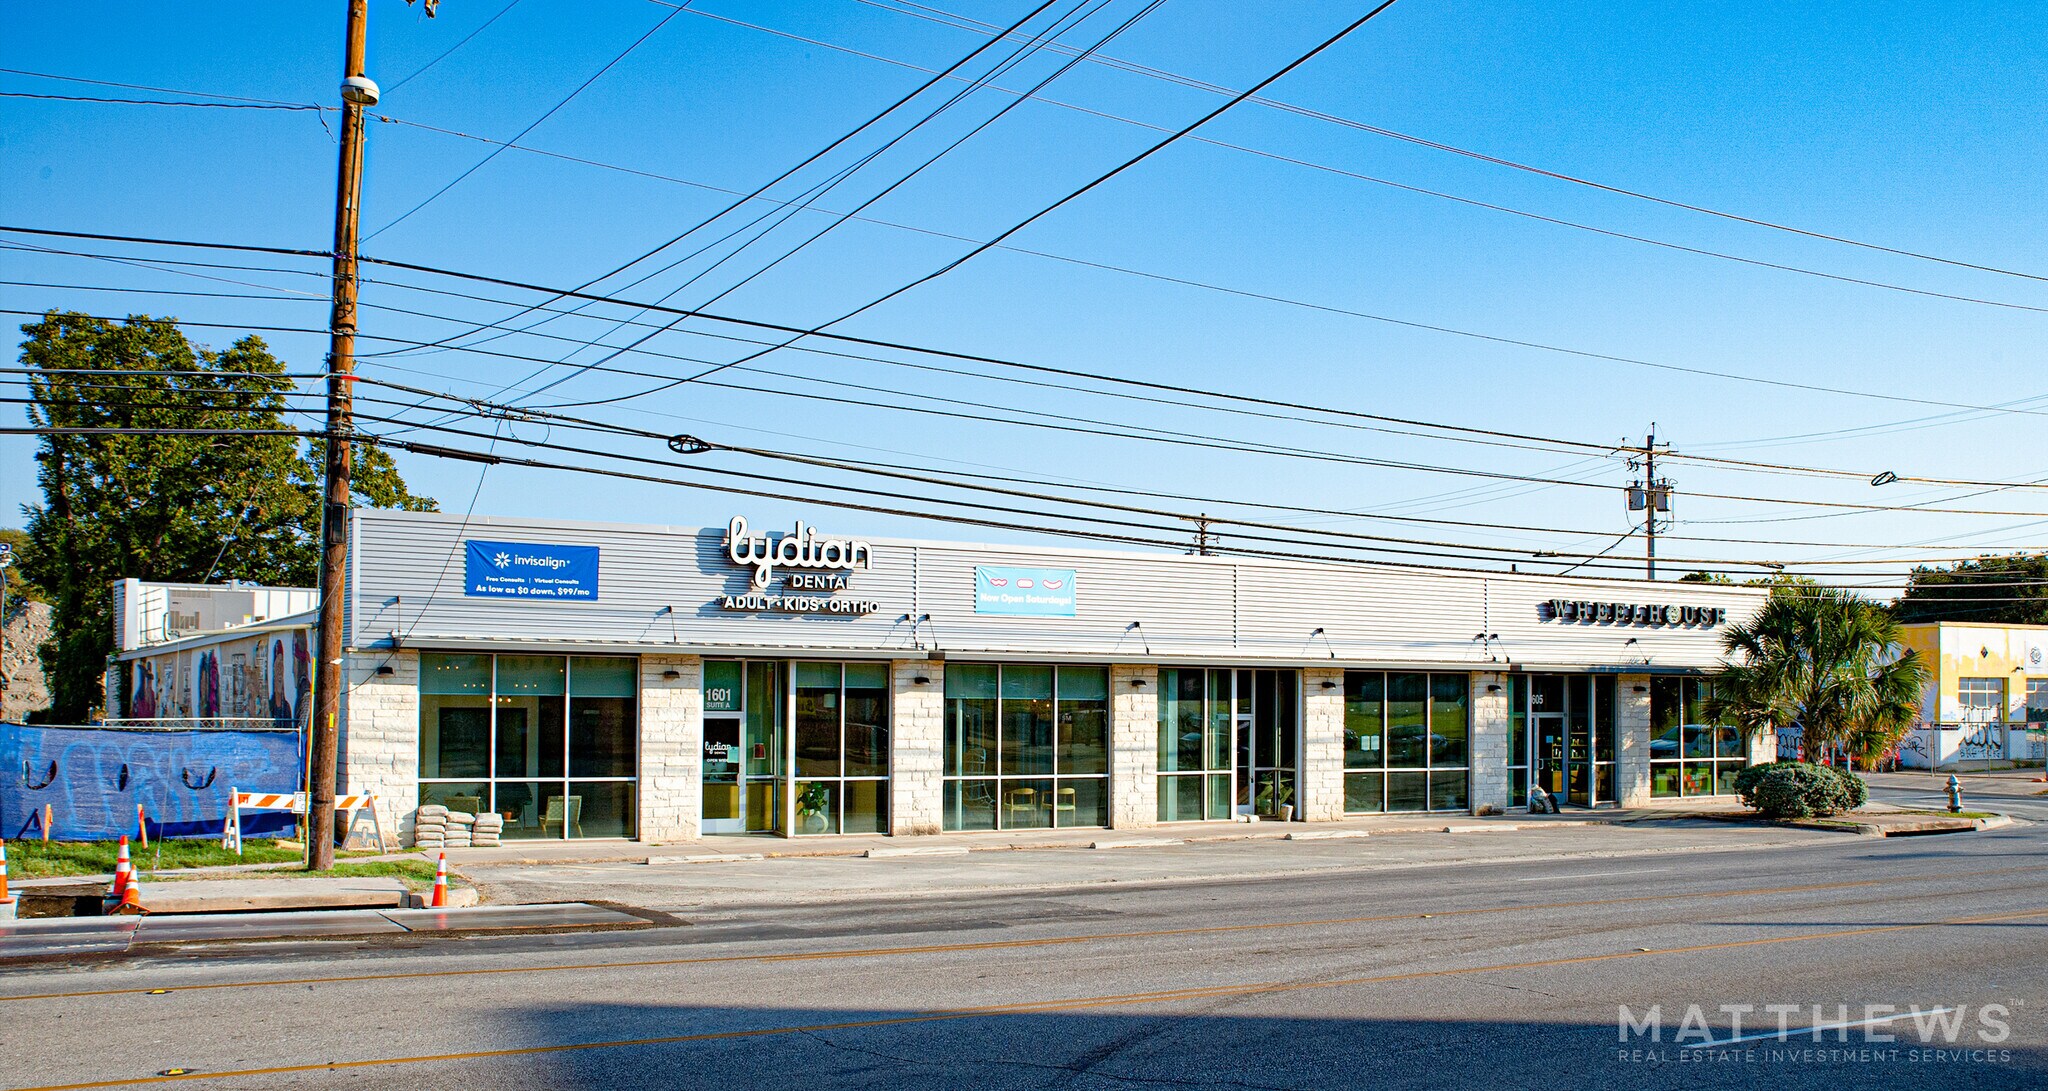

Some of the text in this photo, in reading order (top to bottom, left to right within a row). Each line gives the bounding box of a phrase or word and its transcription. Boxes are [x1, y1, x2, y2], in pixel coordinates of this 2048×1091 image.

[730, 515, 873, 588] lydian
[514, 554, 566, 570] invisalign
[792, 575, 855, 590] DENTAL
[476, 584, 487, 592] As
[488, 585, 504, 593] low
[517, 586, 529, 595] $0
[530, 587, 556, 596] down,
[557, 587, 590, 597] $99/mo
[980, 592, 1000, 603] Now
[1000, 593, 1024, 604] Open
[724, 596, 881, 614] ADULT KIDS ORTHO
[705, 688, 731, 701] 1601
